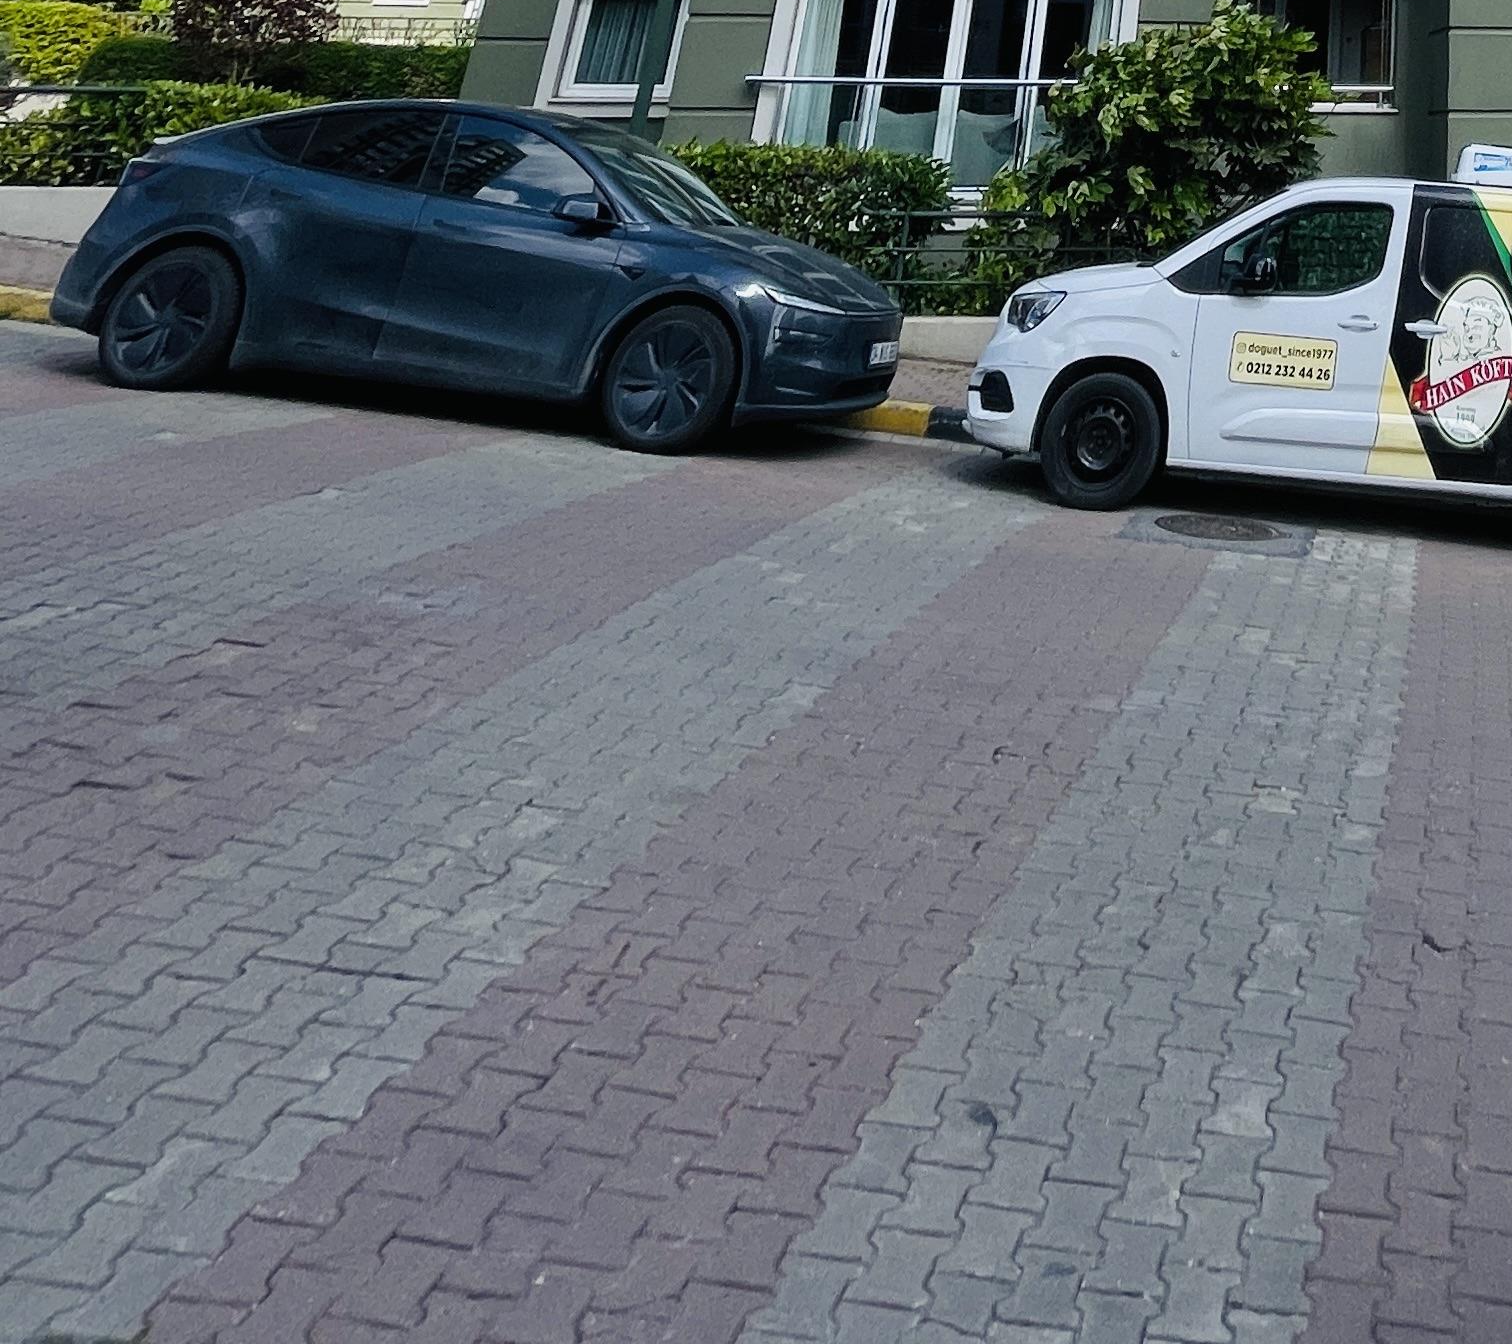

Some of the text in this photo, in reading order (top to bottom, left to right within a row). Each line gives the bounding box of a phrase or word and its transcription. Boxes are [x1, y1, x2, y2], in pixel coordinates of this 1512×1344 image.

[1246, 362, 1331, 381] 0212 232 44 26
